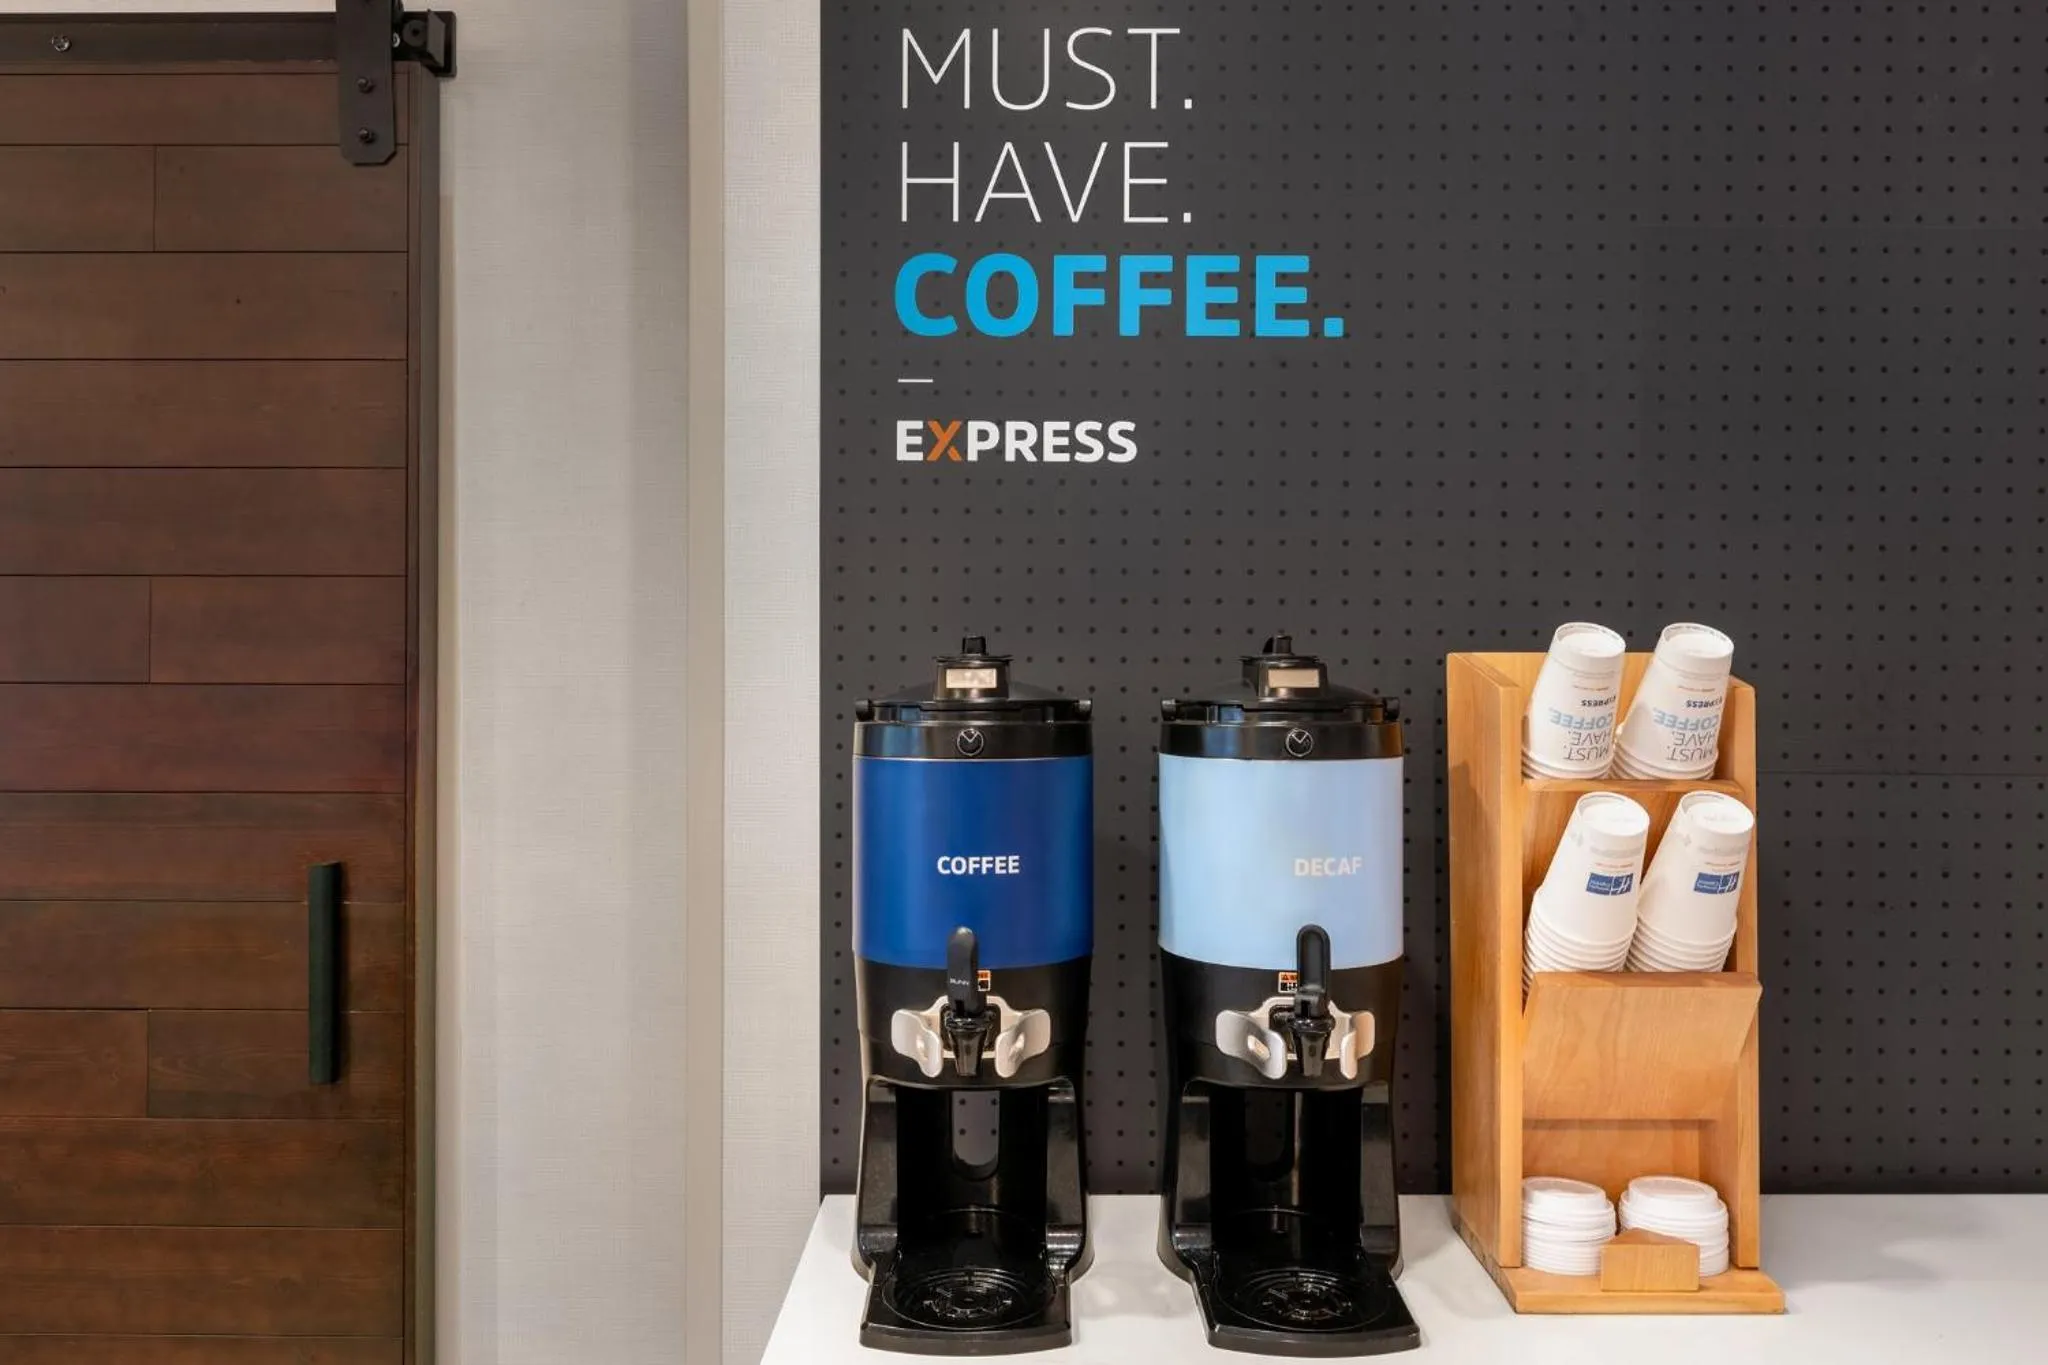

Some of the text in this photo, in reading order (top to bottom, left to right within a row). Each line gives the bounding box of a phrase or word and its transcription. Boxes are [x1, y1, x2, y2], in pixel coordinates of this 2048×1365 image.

[902, 26, 1193, 111] MUST.
[901, 141, 1192, 223] HAVE.
[895, 252, 1344, 338] COFFEE.
[896, 420, 1138, 463] EXPRESS
[1563, 744, 1609, 761] MUST.
[1666, 745, 1714, 761] MUST.
[937, 855, 1020, 875] COFFEE
[1294, 857, 1363, 877] DECAF
